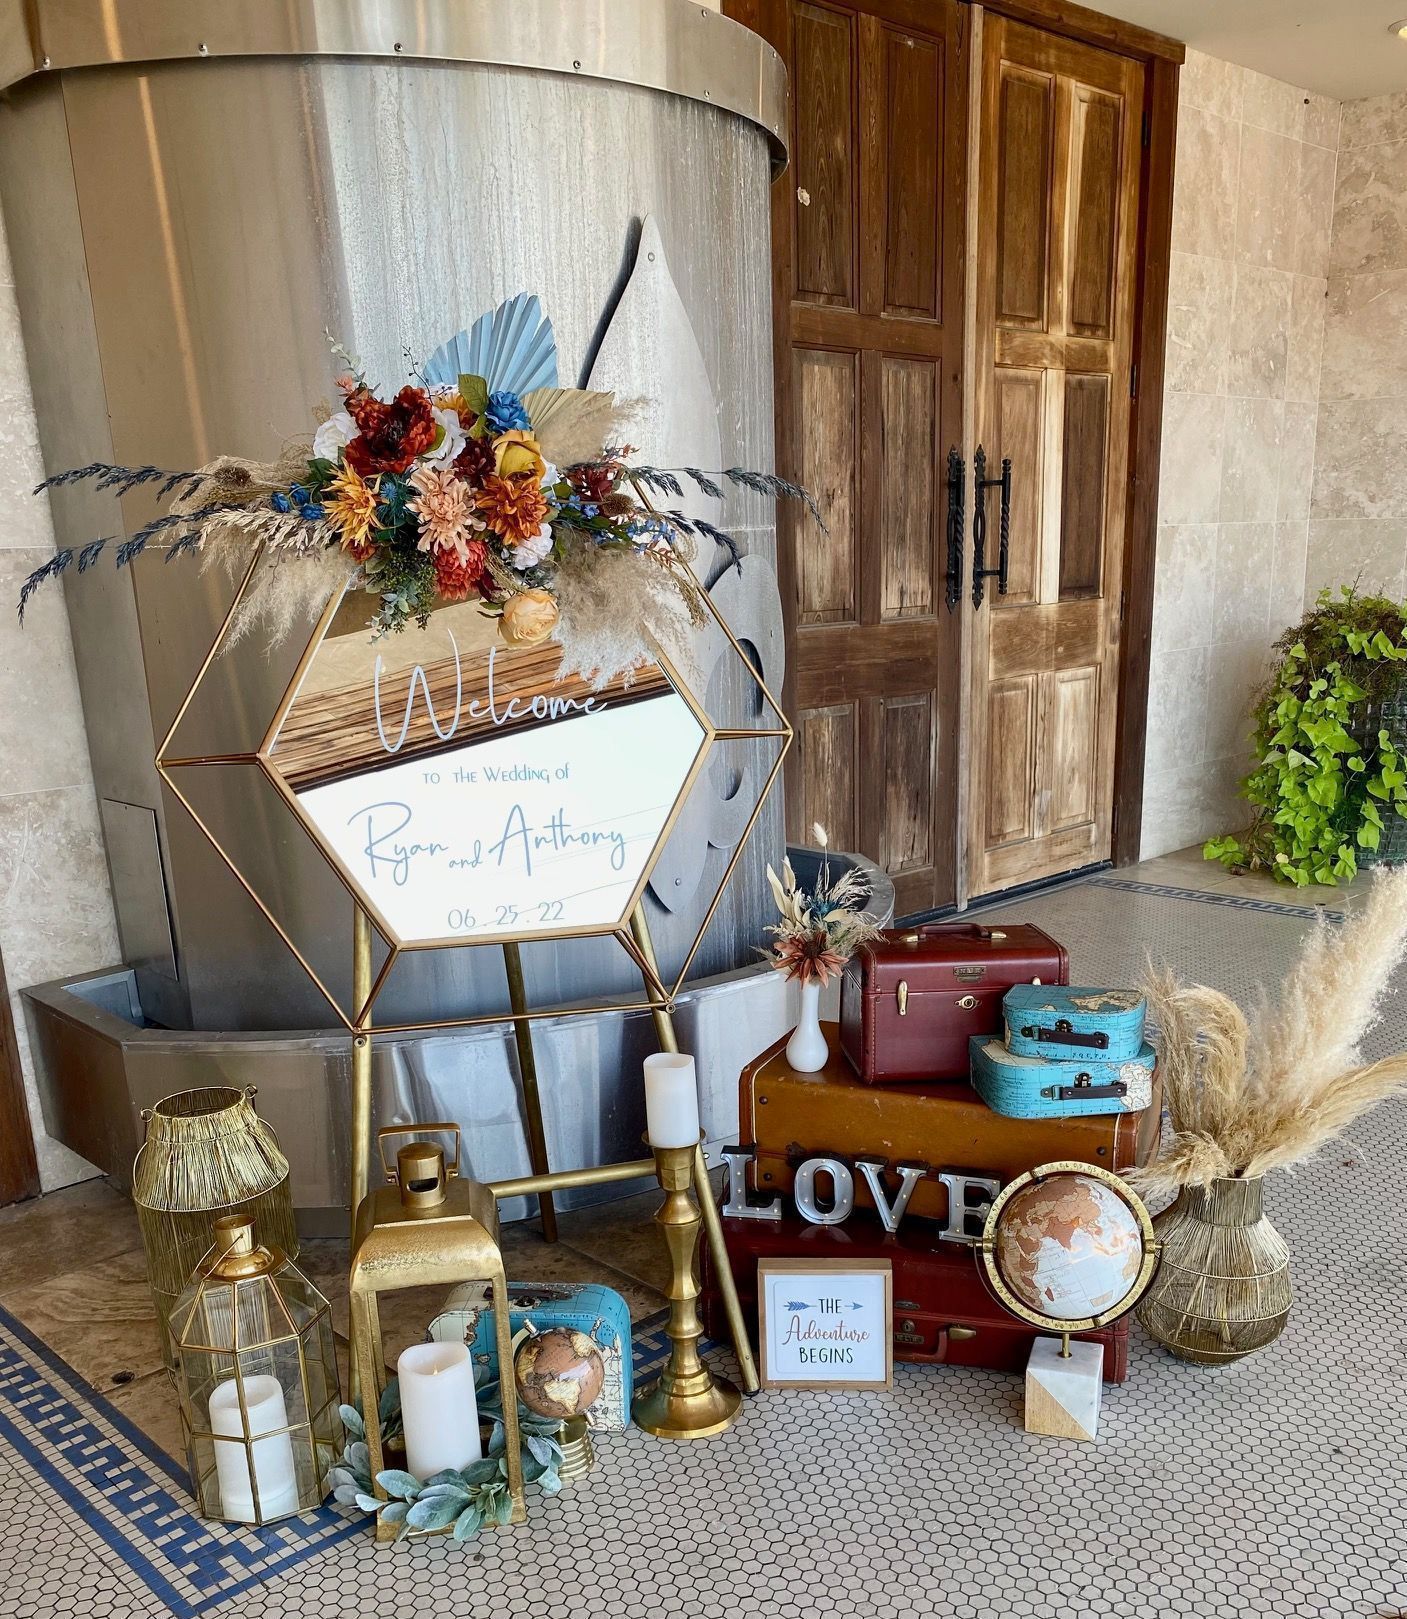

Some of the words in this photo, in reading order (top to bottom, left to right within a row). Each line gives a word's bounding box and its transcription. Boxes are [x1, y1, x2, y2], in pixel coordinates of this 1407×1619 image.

[375, 628, 608, 753] Welcome
[555, 762, 570, 780] of
[347, 801, 449, 886] Ryan
[449, 839, 483, 869] and
[488, 803, 626, 877] Anthony
[720, 1146, 1001, 1244] LOVE
[818, 1298, 842, 1314] THE
[781, 1314, 870, 1346] Adventure
[799, 1346, 853, 1364] BEGINS
